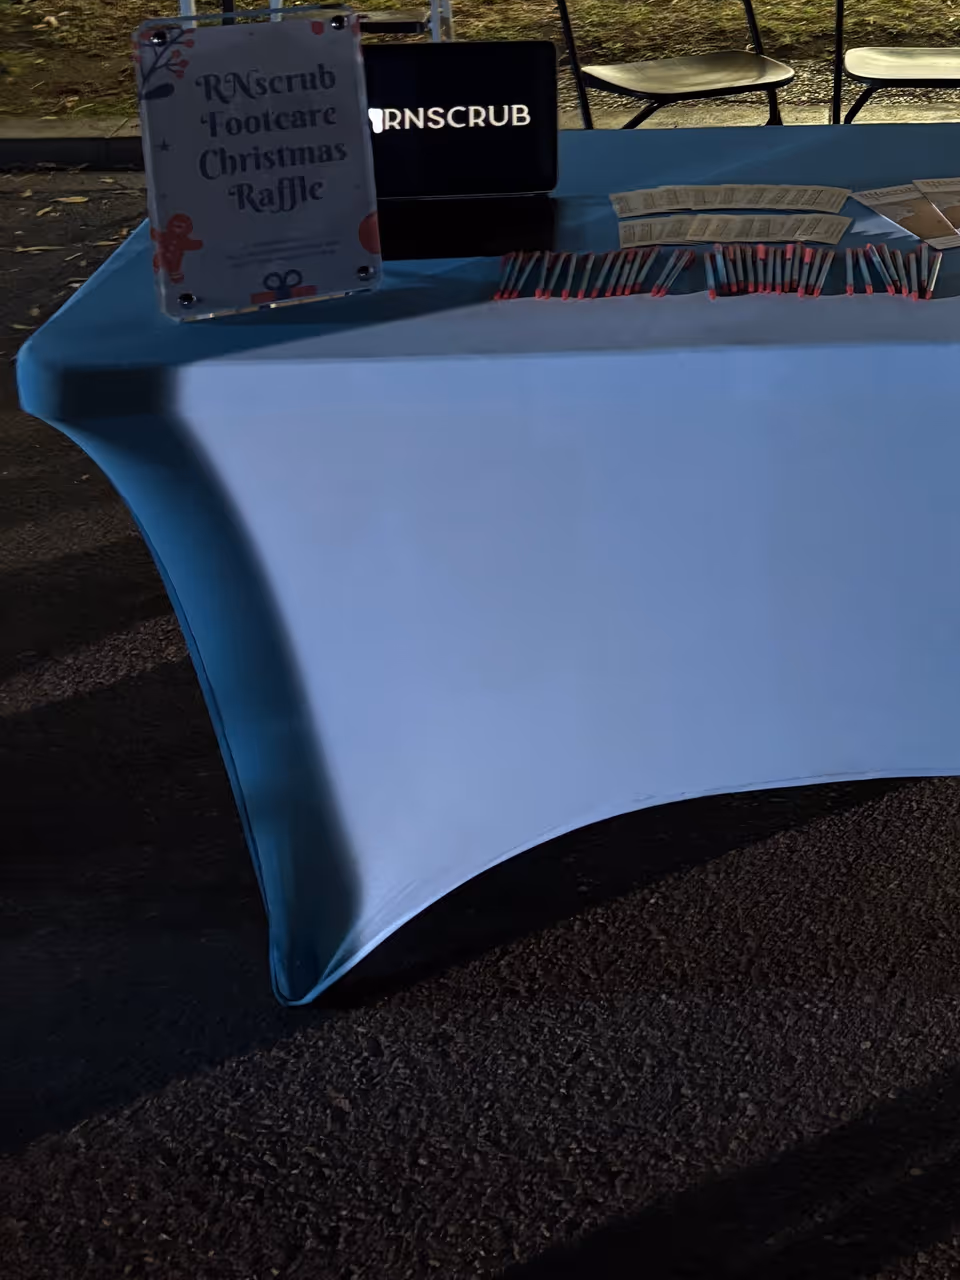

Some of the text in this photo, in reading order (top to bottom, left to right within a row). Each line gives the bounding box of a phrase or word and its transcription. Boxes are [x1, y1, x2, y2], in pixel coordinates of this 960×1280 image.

[195, 63, 337, 103] RNscrub
[199, 103, 337, 139] Footcare
[384, 104, 531, 131] RNSCRUB
[199, 138, 348, 181] Christmas
[227, 176, 324, 214] Raffle
